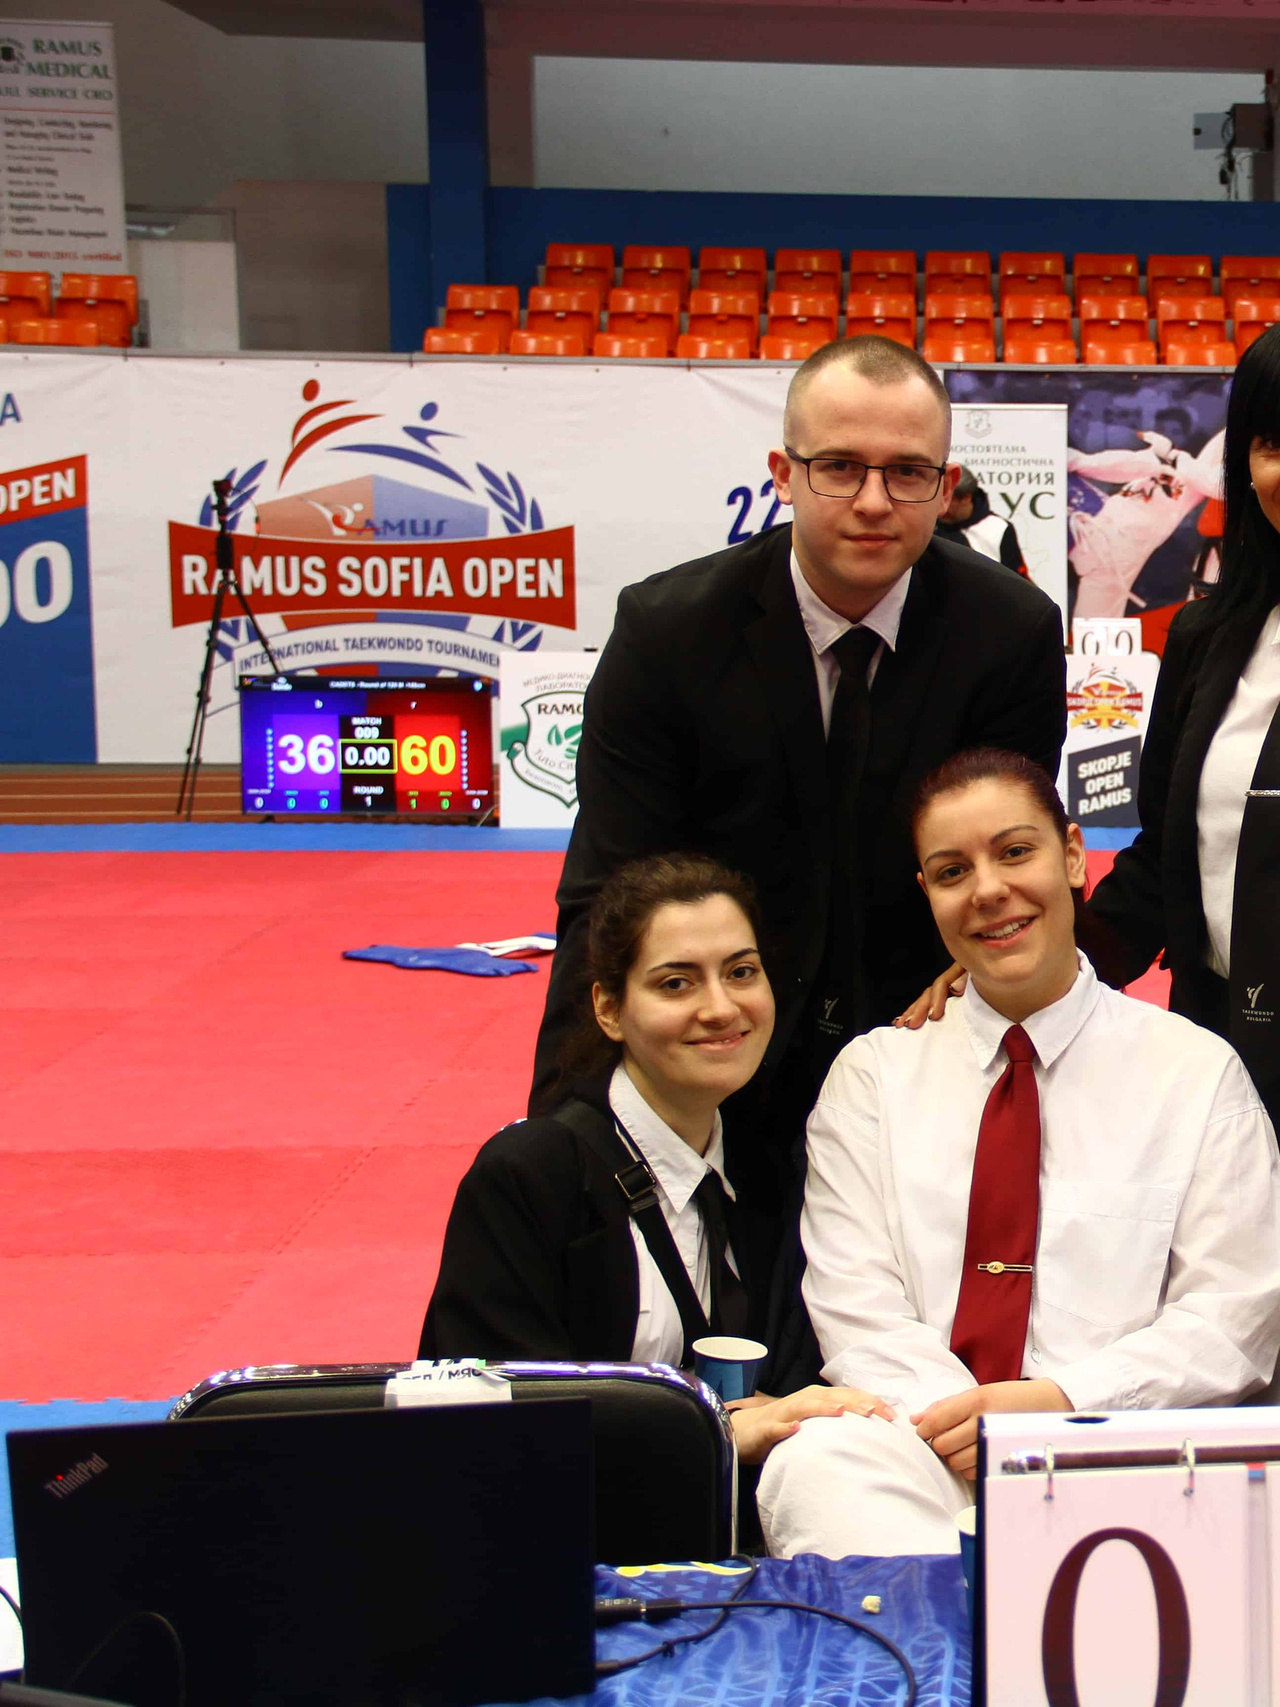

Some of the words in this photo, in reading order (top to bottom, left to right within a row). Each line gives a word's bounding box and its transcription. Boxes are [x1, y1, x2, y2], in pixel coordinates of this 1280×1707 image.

[337, 556, 454, 598] SOFIA
[462, 557, 564, 599] OPEN
[344, 636, 424, 653] TAEKWONDO
[351, 716, 382, 727] MATCH
[354, 726, 380, 740] 009
[277, 733, 336, 775] 36
[344, 746, 391, 767] 0.00
[400, 734, 457, 776] 60
[1077, 750, 1132, 779] SKOPJE
[353, 785, 385, 796] ROUND
[1085, 771, 1125, 796] OPEN
[254, 796, 265, 810] 0
[286, 797, 297, 810] 0
[319, 797, 329, 810] 0
[364, 795, 372, 808] 1
[409, 797, 418, 810] 1
[440, 797, 450, 811] 0
[471, 797, 482, 811] 0
[1078, 787, 1132, 816] RAMUS
[43, 1452, 109, 1499] ThinkPad
